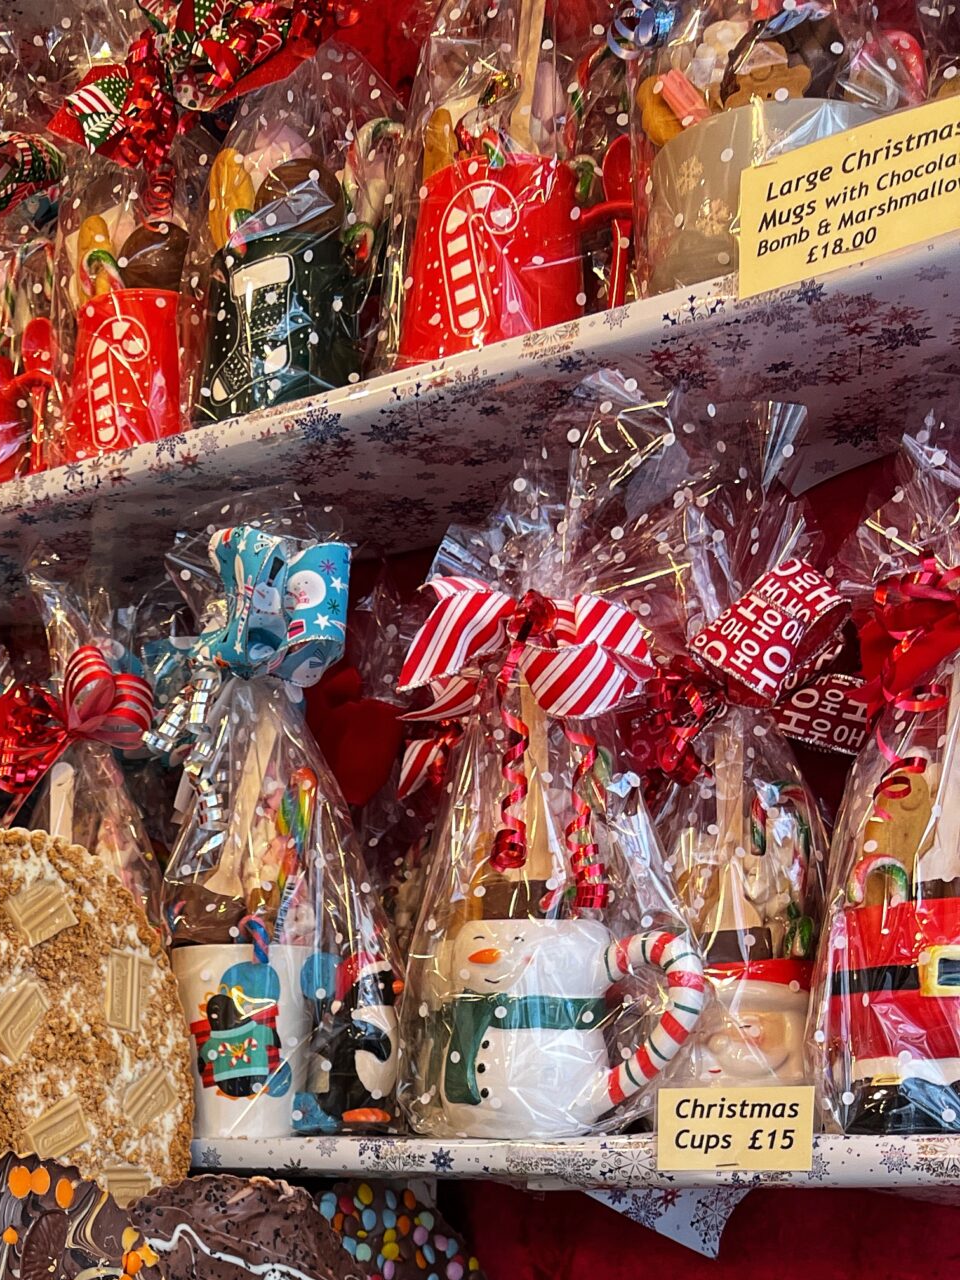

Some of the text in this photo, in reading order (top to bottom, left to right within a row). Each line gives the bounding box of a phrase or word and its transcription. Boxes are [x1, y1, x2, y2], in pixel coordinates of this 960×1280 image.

[758, 152, 960, 233] Mugs with Chocola
[766, 165, 833, 202] Large
[757, 178, 960, 257] Bomb & Marshmallo
[806, 226, 877, 265] £18.00
[675, 1097, 799, 1119] Christmas
[674, 1129, 795, 1154] Cups £15
